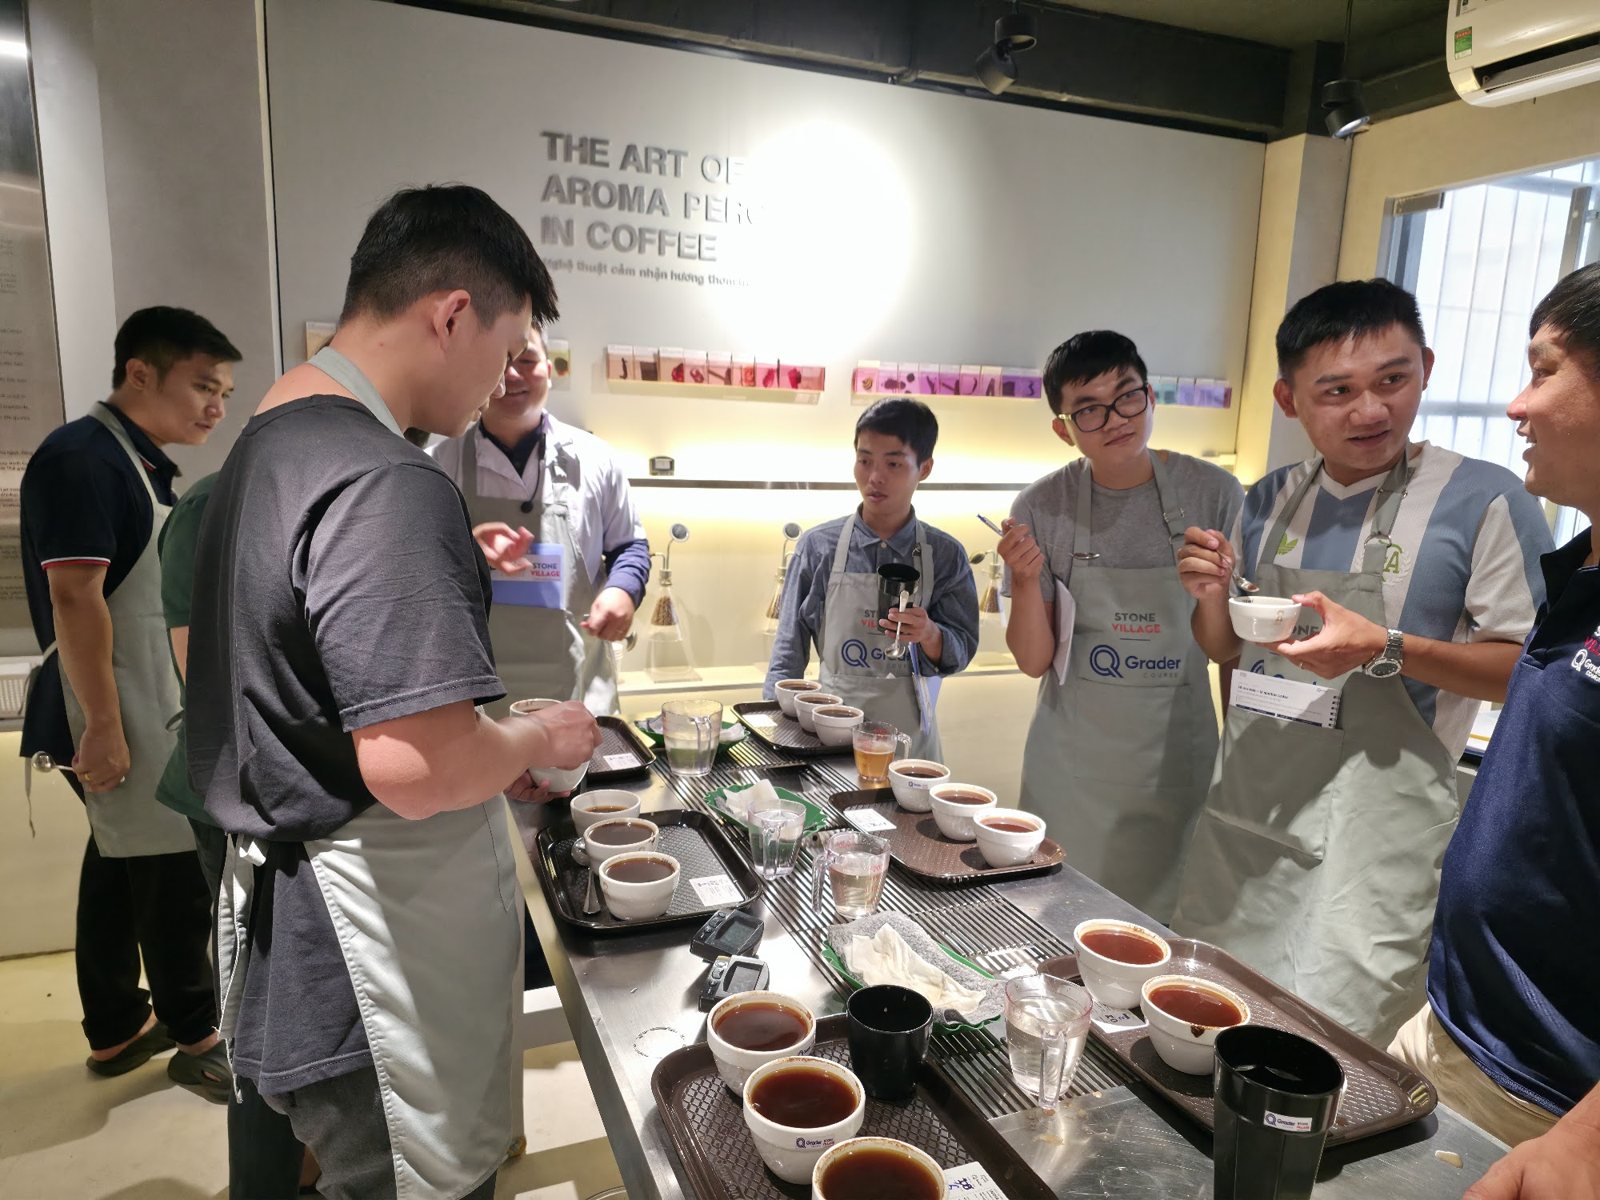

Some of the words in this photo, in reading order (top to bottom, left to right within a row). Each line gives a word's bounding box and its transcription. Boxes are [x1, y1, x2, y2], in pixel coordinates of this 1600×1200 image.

[540, 131, 610, 168] THE
[619, 144, 688, 178] ART
[700, 154, 745, 184] OF
[541, 174, 670, 216] AROMA
[541, 216, 574, 247] IN
[586, 221, 717, 262] COFFEE
[639, 267, 668, 282] nhận
[671, 270, 704, 286] hương
[1112, 623, 1162, 633] VILLAGE
[1114, 612, 1156, 622] STONE
[1090, 644, 1124, 678] Q
[1125, 655, 1181, 670] Grader
